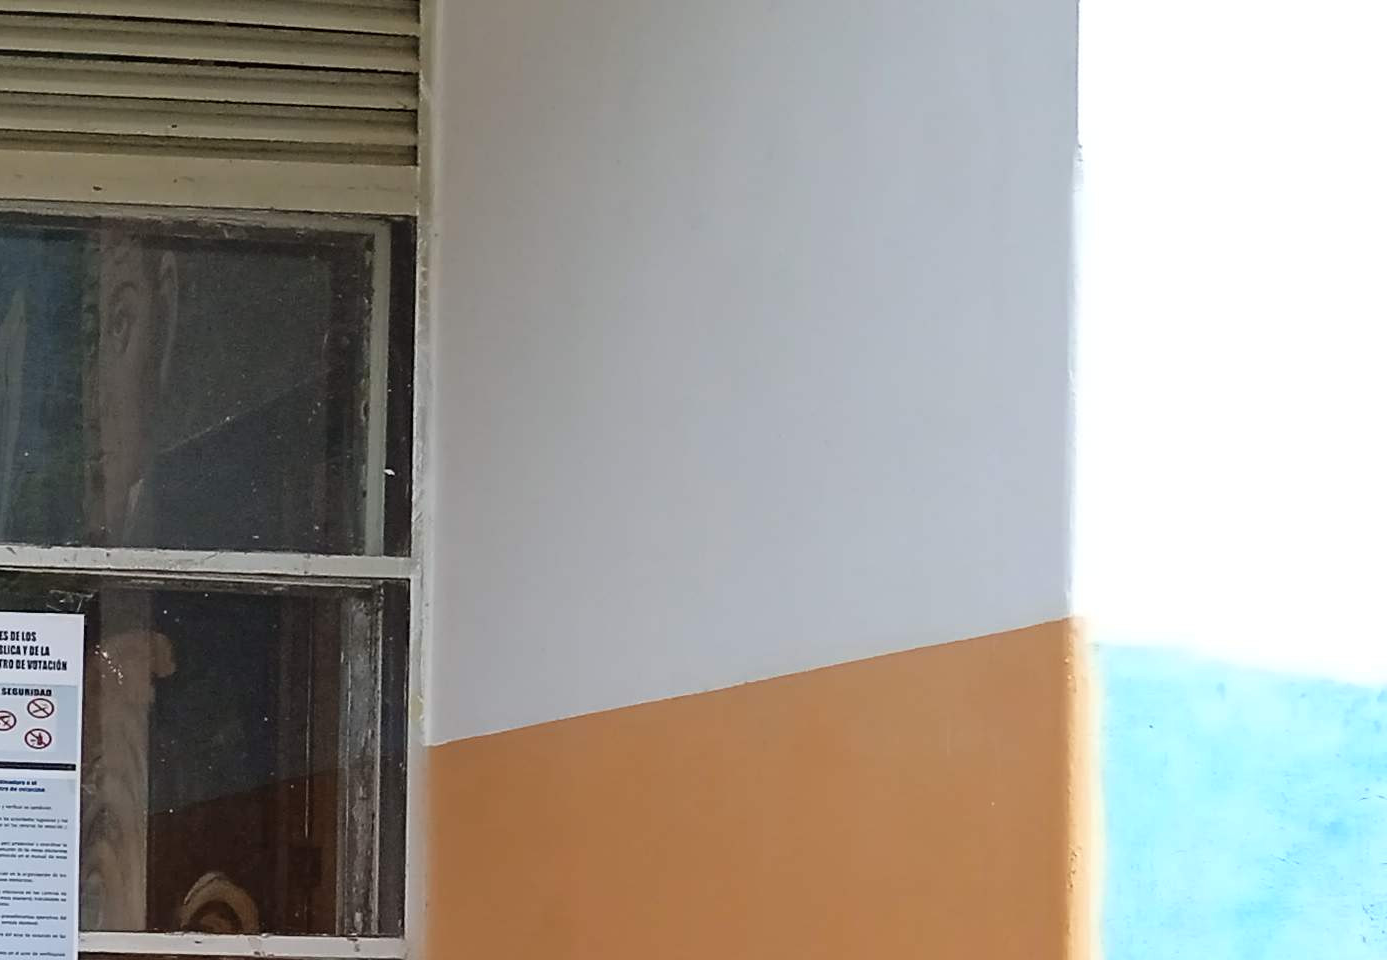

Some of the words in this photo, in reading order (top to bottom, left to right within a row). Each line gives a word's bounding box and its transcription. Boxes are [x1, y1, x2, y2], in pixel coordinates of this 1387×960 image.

[10, 630, 20, 641] DE
[21, 631, 37, 642] LOS
[22, 645, 28, 656] Y
[29, 645, 39, 656] DE
[40, 646, 50, 656] LA
[15, 659, 26, 670] DE
[26, 659, 68, 671] VOTACIÓN
[1, 687, 52, 697] SEGURIDAD
